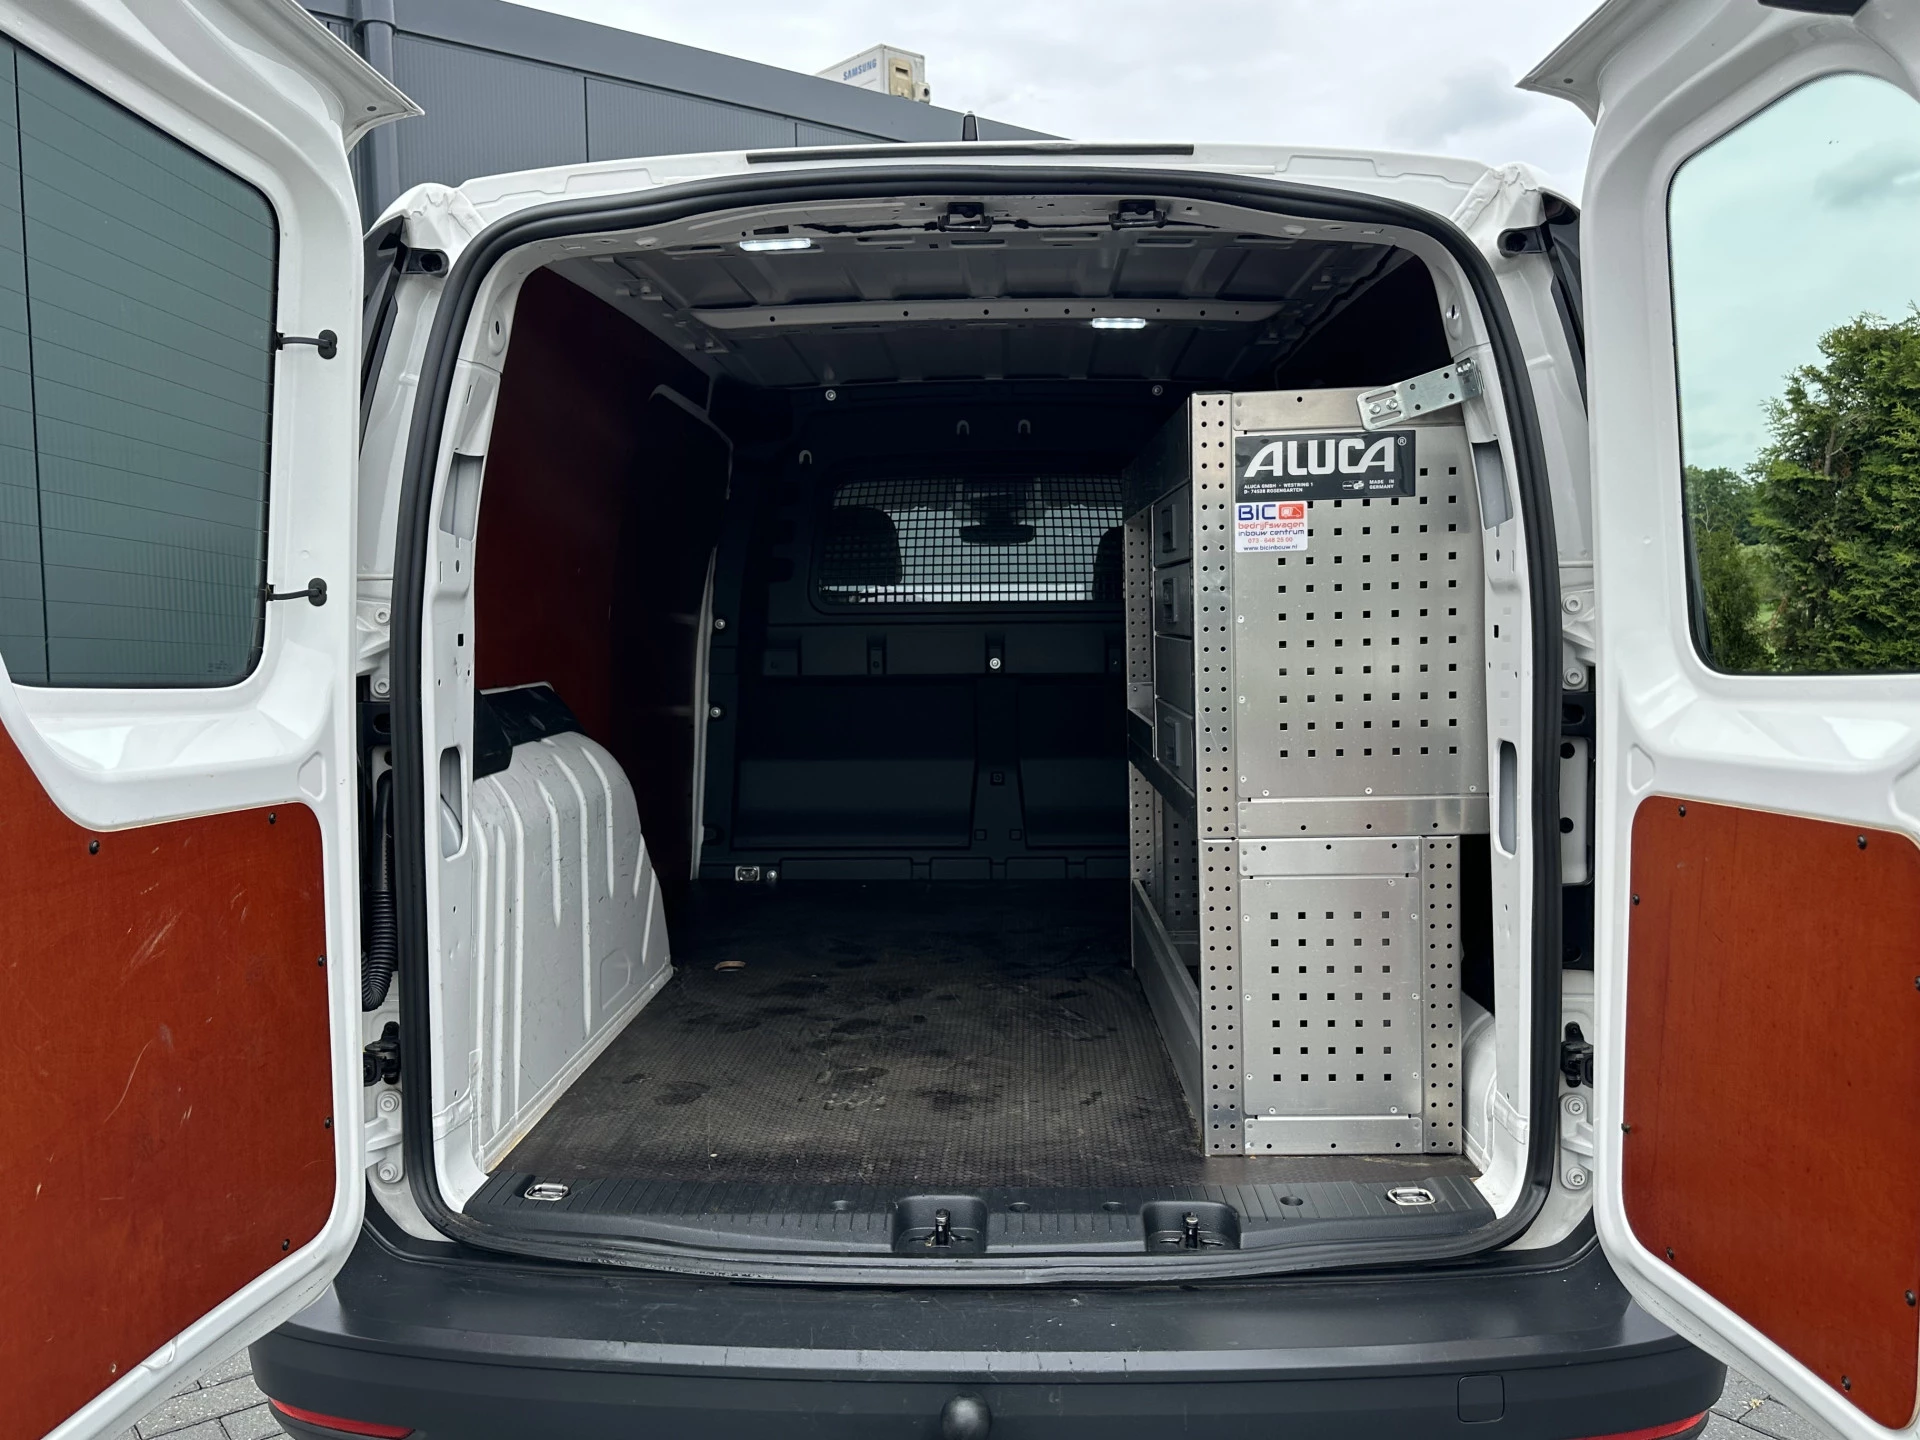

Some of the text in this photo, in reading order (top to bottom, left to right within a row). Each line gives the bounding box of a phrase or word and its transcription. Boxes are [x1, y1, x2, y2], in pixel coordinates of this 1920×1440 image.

[843, 58, 877, 81] SAMSUNG
[1238, 504, 1276, 521] BIC
[1238, 521, 1305, 530] bedrijfswagen
